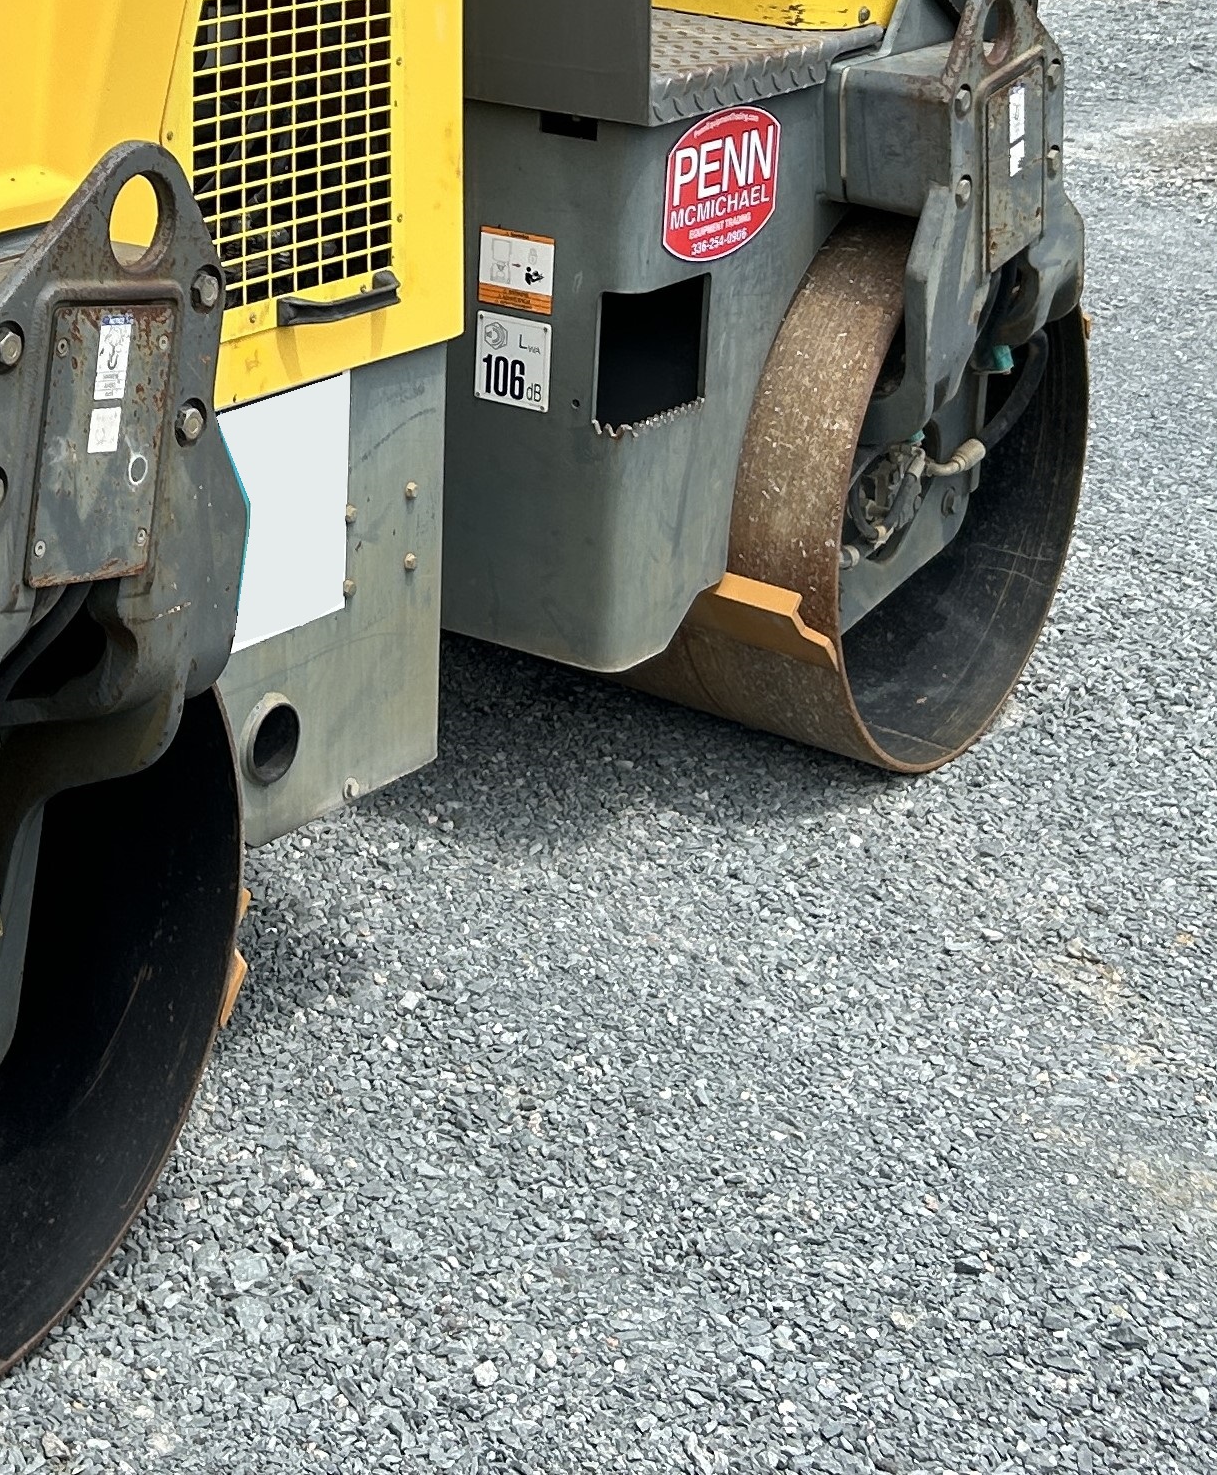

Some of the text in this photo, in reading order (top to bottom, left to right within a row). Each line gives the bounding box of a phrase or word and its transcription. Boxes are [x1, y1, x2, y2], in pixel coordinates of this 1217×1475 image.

[672, 124, 774, 207] PENN
[670, 183, 771, 230] MCMICHAEL
[483, 353, 542, 402] 106 dB
